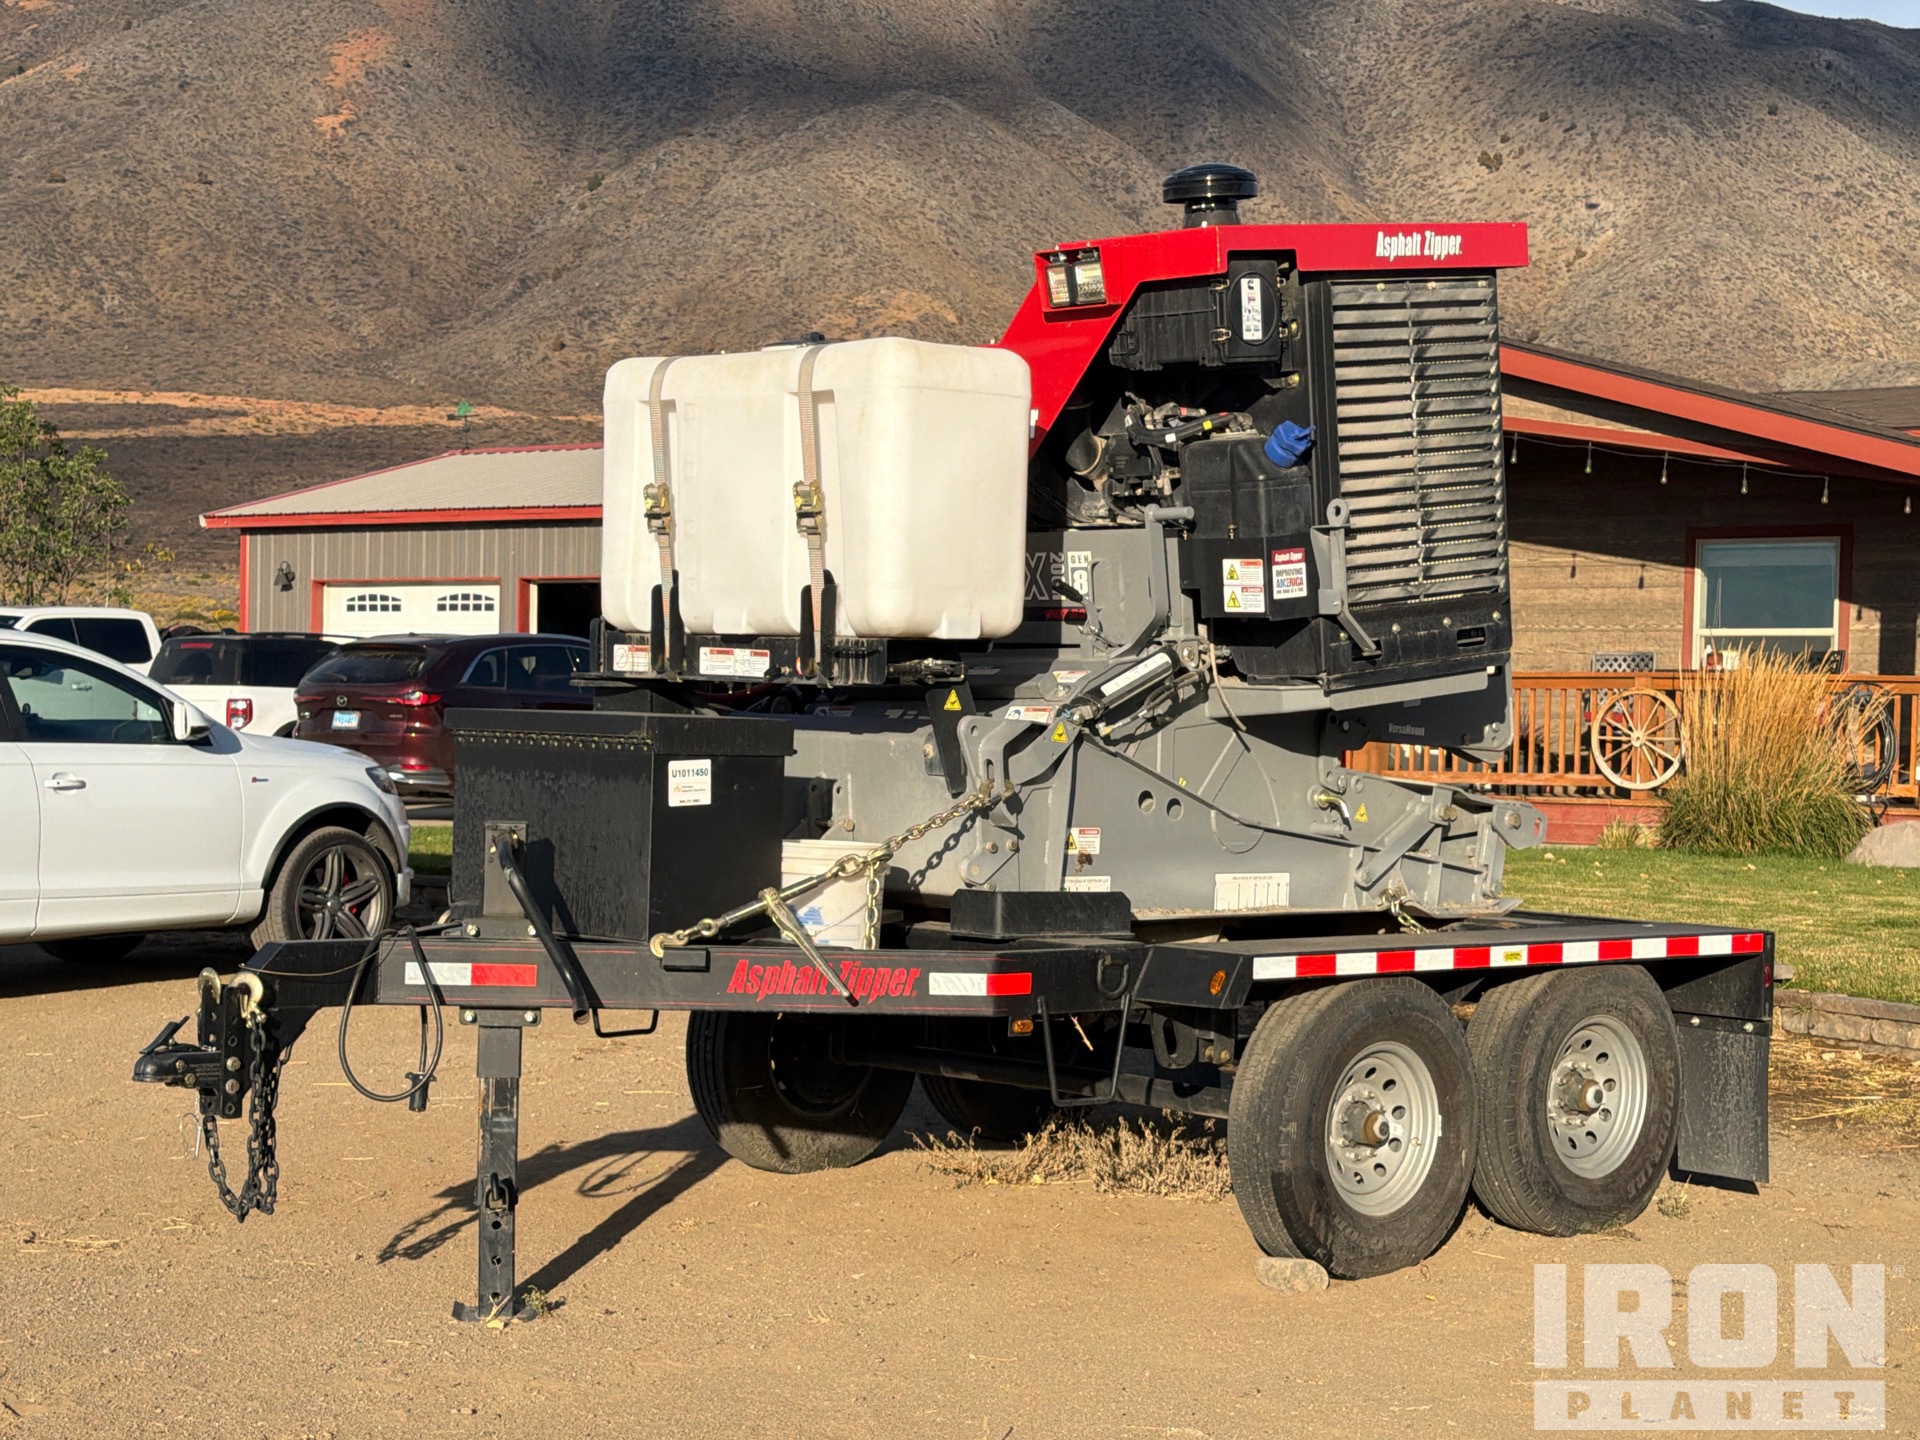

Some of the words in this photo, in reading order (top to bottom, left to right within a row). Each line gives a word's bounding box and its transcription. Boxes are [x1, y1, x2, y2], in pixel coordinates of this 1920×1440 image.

[1376, 231, 1421, 262] Asphalt
[1424, 230, 1462, 261] Zipper
[1071, 555, 1089, 564] GEN
[1275, 568, 1303, 577] IMPROVING
[1276, 577, 1304, 588] AMERICA
[671, 768, 709, 778] U1011450
[727, 959, 833, 1002] Asphalt
[831, 960, 920, 1004] Zipper
